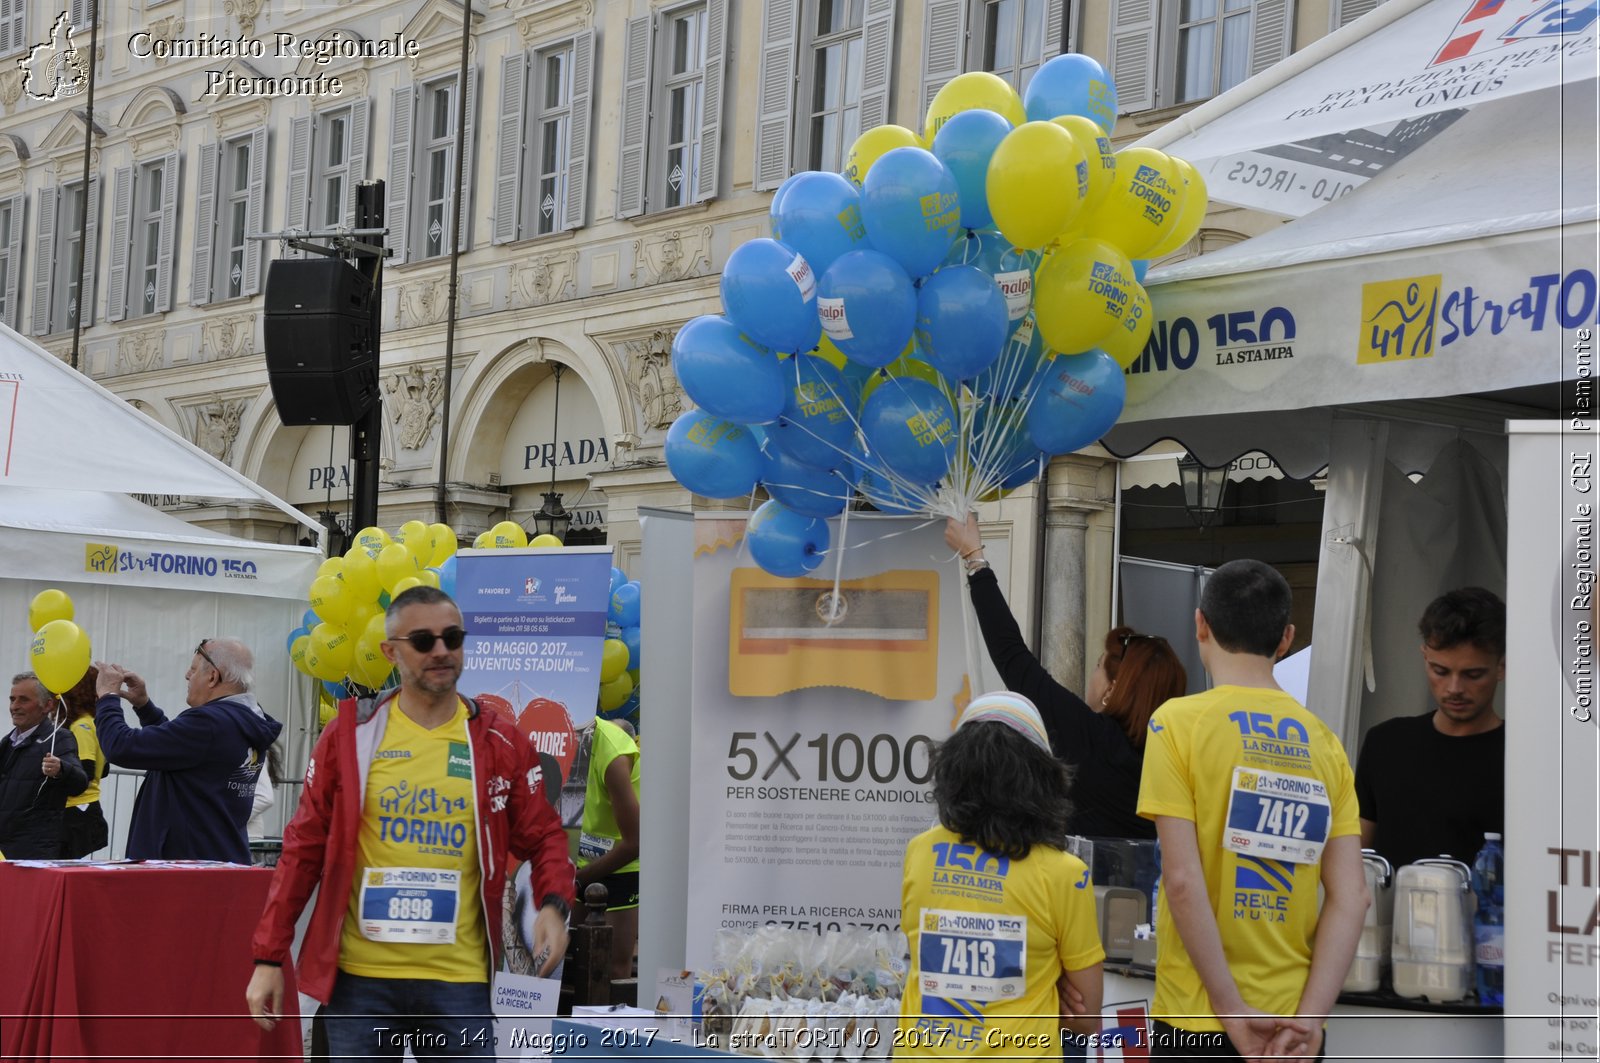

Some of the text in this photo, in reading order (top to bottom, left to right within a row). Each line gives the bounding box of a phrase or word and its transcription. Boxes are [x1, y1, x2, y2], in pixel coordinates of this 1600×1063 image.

[1320, 58, 1493, 104] FONDAZIONE
[1414, 74, 1507, 108] ONLUS
[1128, 181, 1172, 213] TORINO
[1088, 278, 1128, 306] TORINO
[1207, 305, 1296, 347] 150
[1216, 345, 1295, 366] LA STAMPA
[523, 437, 609, 470] PRADA
[221, 559, 257, 573] 150
[474, 615, 493, 623] Biglietti
[498, 616, 513, 624] partire
[538, 625, 549, 633] 636
[475, 641, 490, 655] 30
[493, 641, 537, 655] MAGGIO
[540, 641, 567, 656] 2017
[464, 657, 522, 671] JUVENTUS
[524, 658, 574, 672] STADIUM
[1228, 711, 1309, 744] 150
[726, 730, 935, 785] 5X1000
[1243, 740, 1311, 759] LA STAMPA
[526, 765, 543, 786] 15
[726, 787, 754, 799] PER
[757, 787, 850, 801] SOSTENERE
[1256, 797, 1310, 839] 7412
[379, 817, 466, 849] TORINO
[932, 842, 1010, 877] 150
[1546, 847, 1600, 888] TI
[933, 872, 1003, 892] LA STAMPA
[388, 896, 433, 920] 8898
[722, 904, 865, 918] FIRMA PER LA RICERCA
[1234, 893, 1289, 911] REALE
[1234, 910, 1286, 923] MUUA
[941, 937, 996, 978] 7413
[496, 996, 533, 1010] LA RICERCA
[497, 986, 542, 1001] CAMPIONI PER
[1547, 991, 1579, 1007] Ogni
